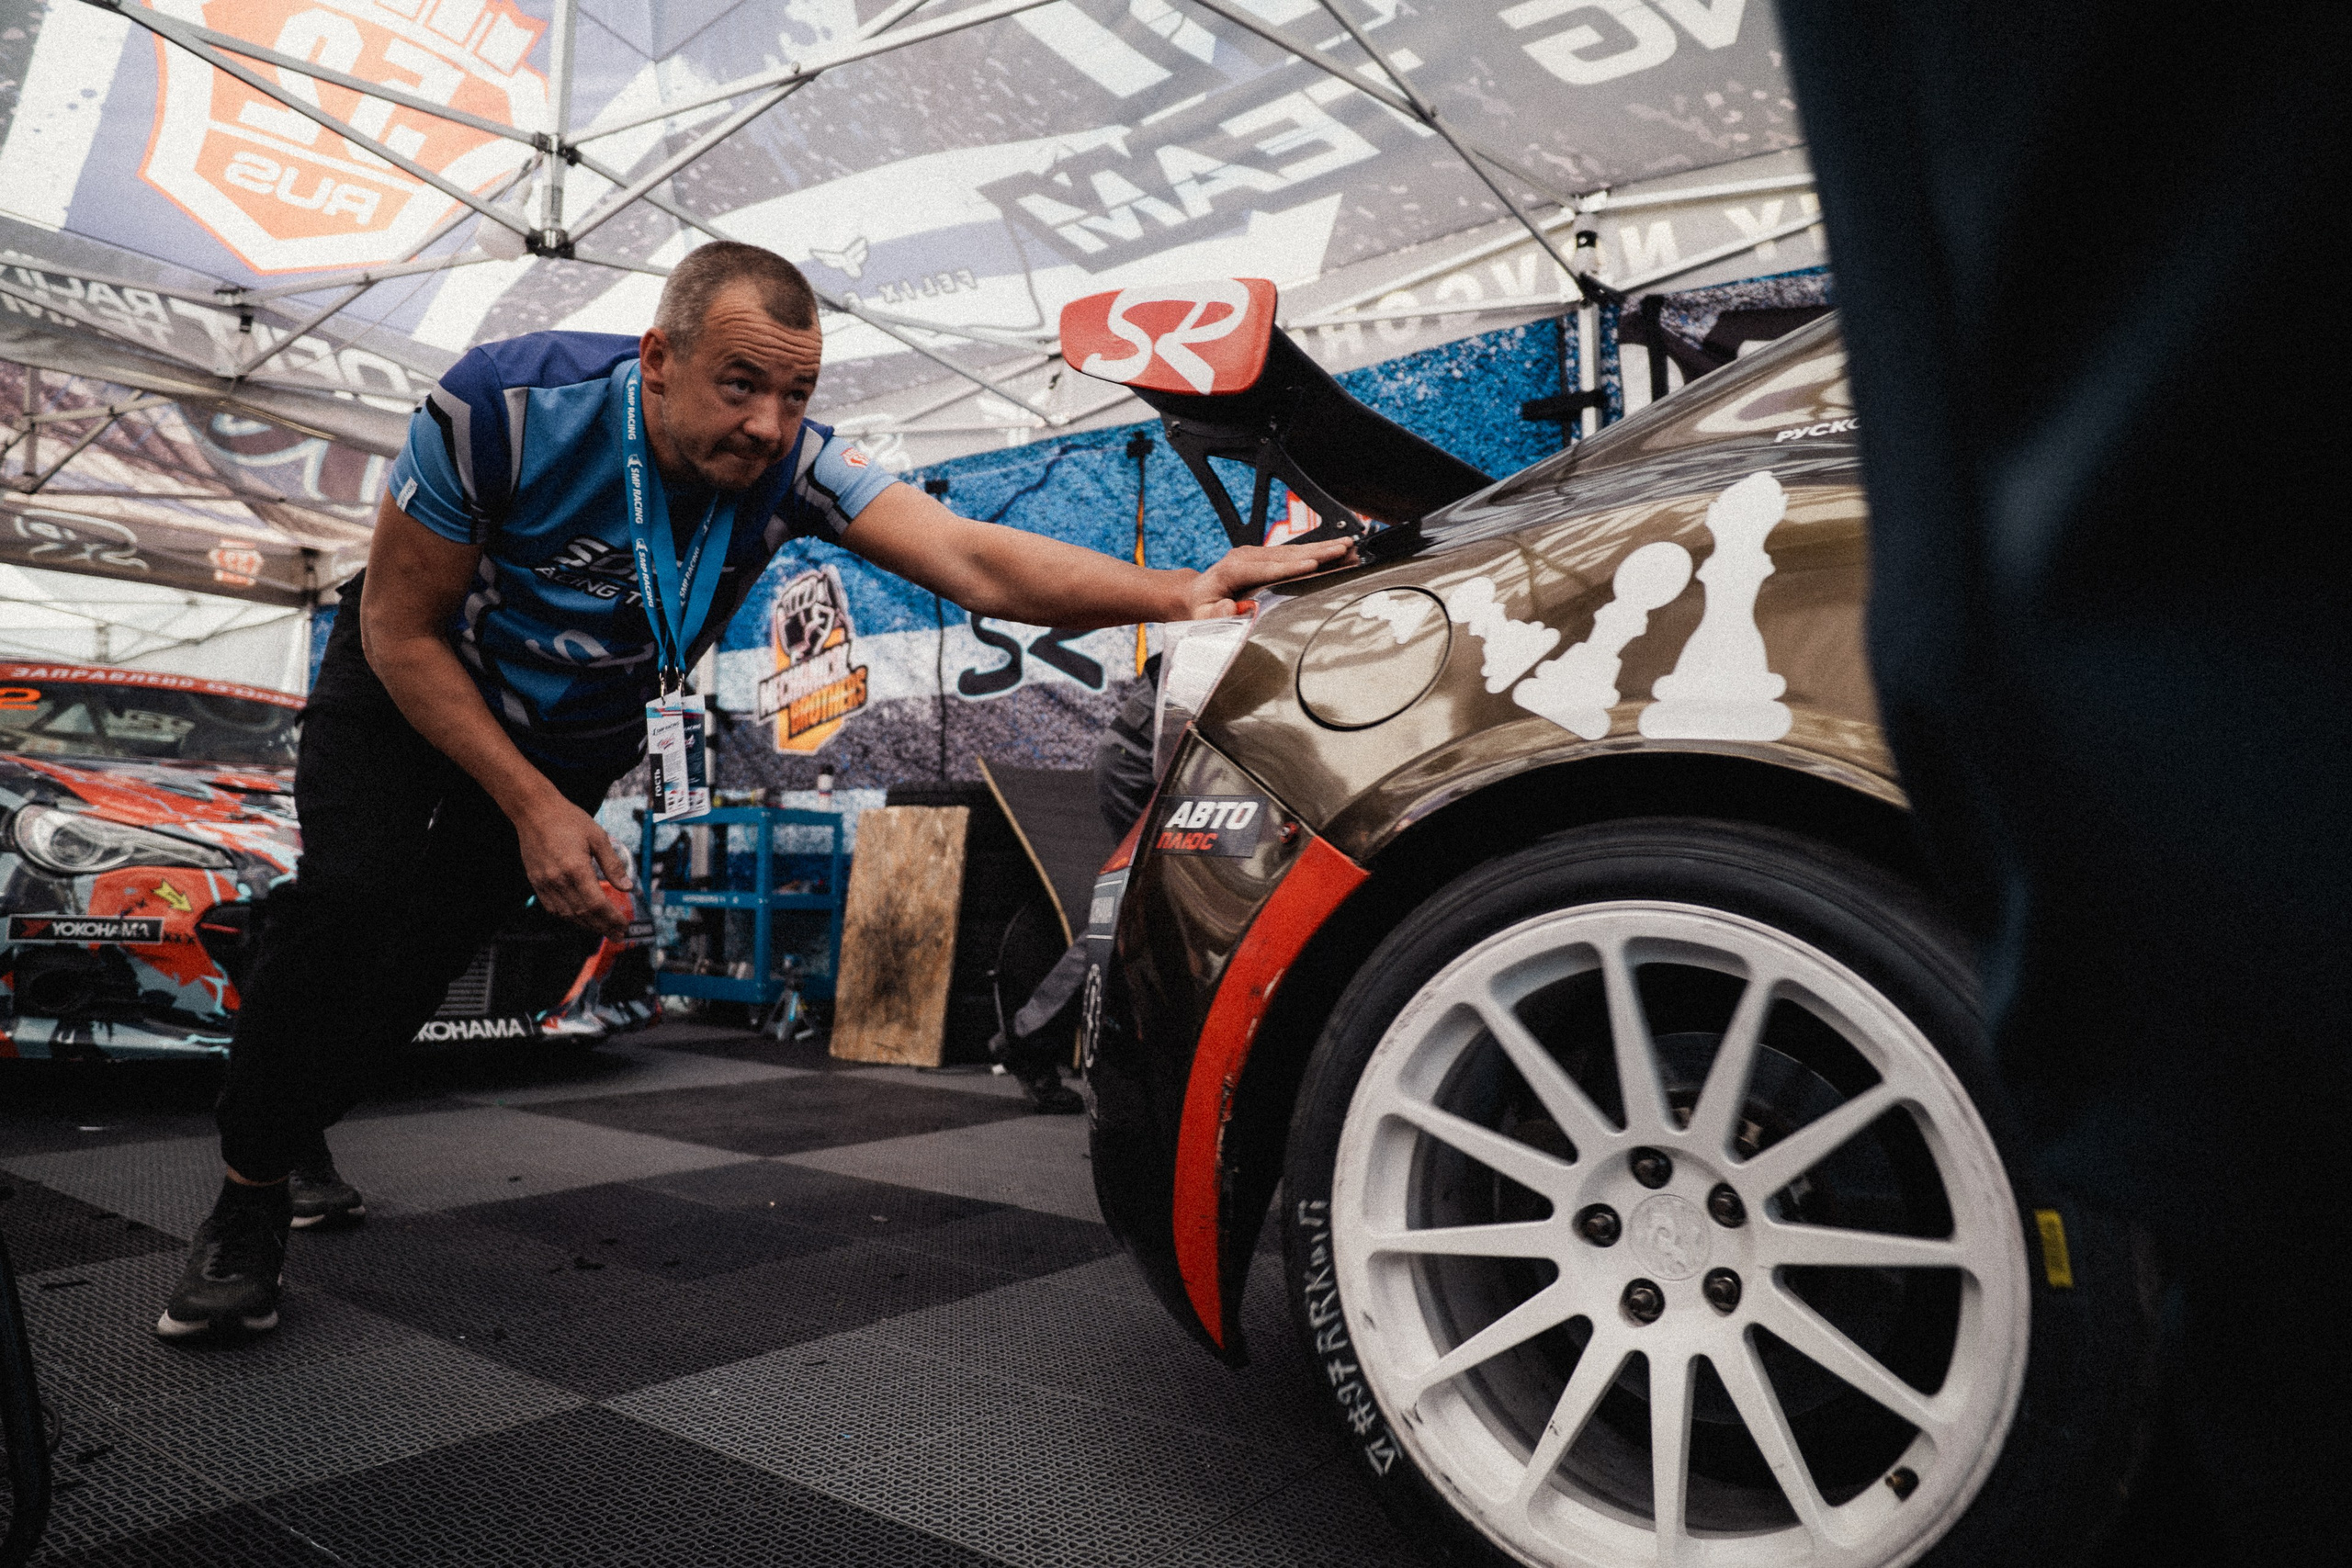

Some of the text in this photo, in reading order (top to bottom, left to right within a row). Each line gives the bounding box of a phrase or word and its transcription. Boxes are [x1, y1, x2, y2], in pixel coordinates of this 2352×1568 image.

[628, 387, 637, 440] SMP RACING
[630, 468, 643, 525] SMP RACING
[535, 567, 620, 597] ACING
[639, 551, 655, 608] SMP RACING
[679, 547, 700, 598] SMP RACING
[654, 769, 662, 796] ГОСТЬ
[1165, 801, 1259, 830] АВТО
[1156, 831, 1218, 851] ПЛЮС
[412, 1018, 528, 1043] KOHAMA
